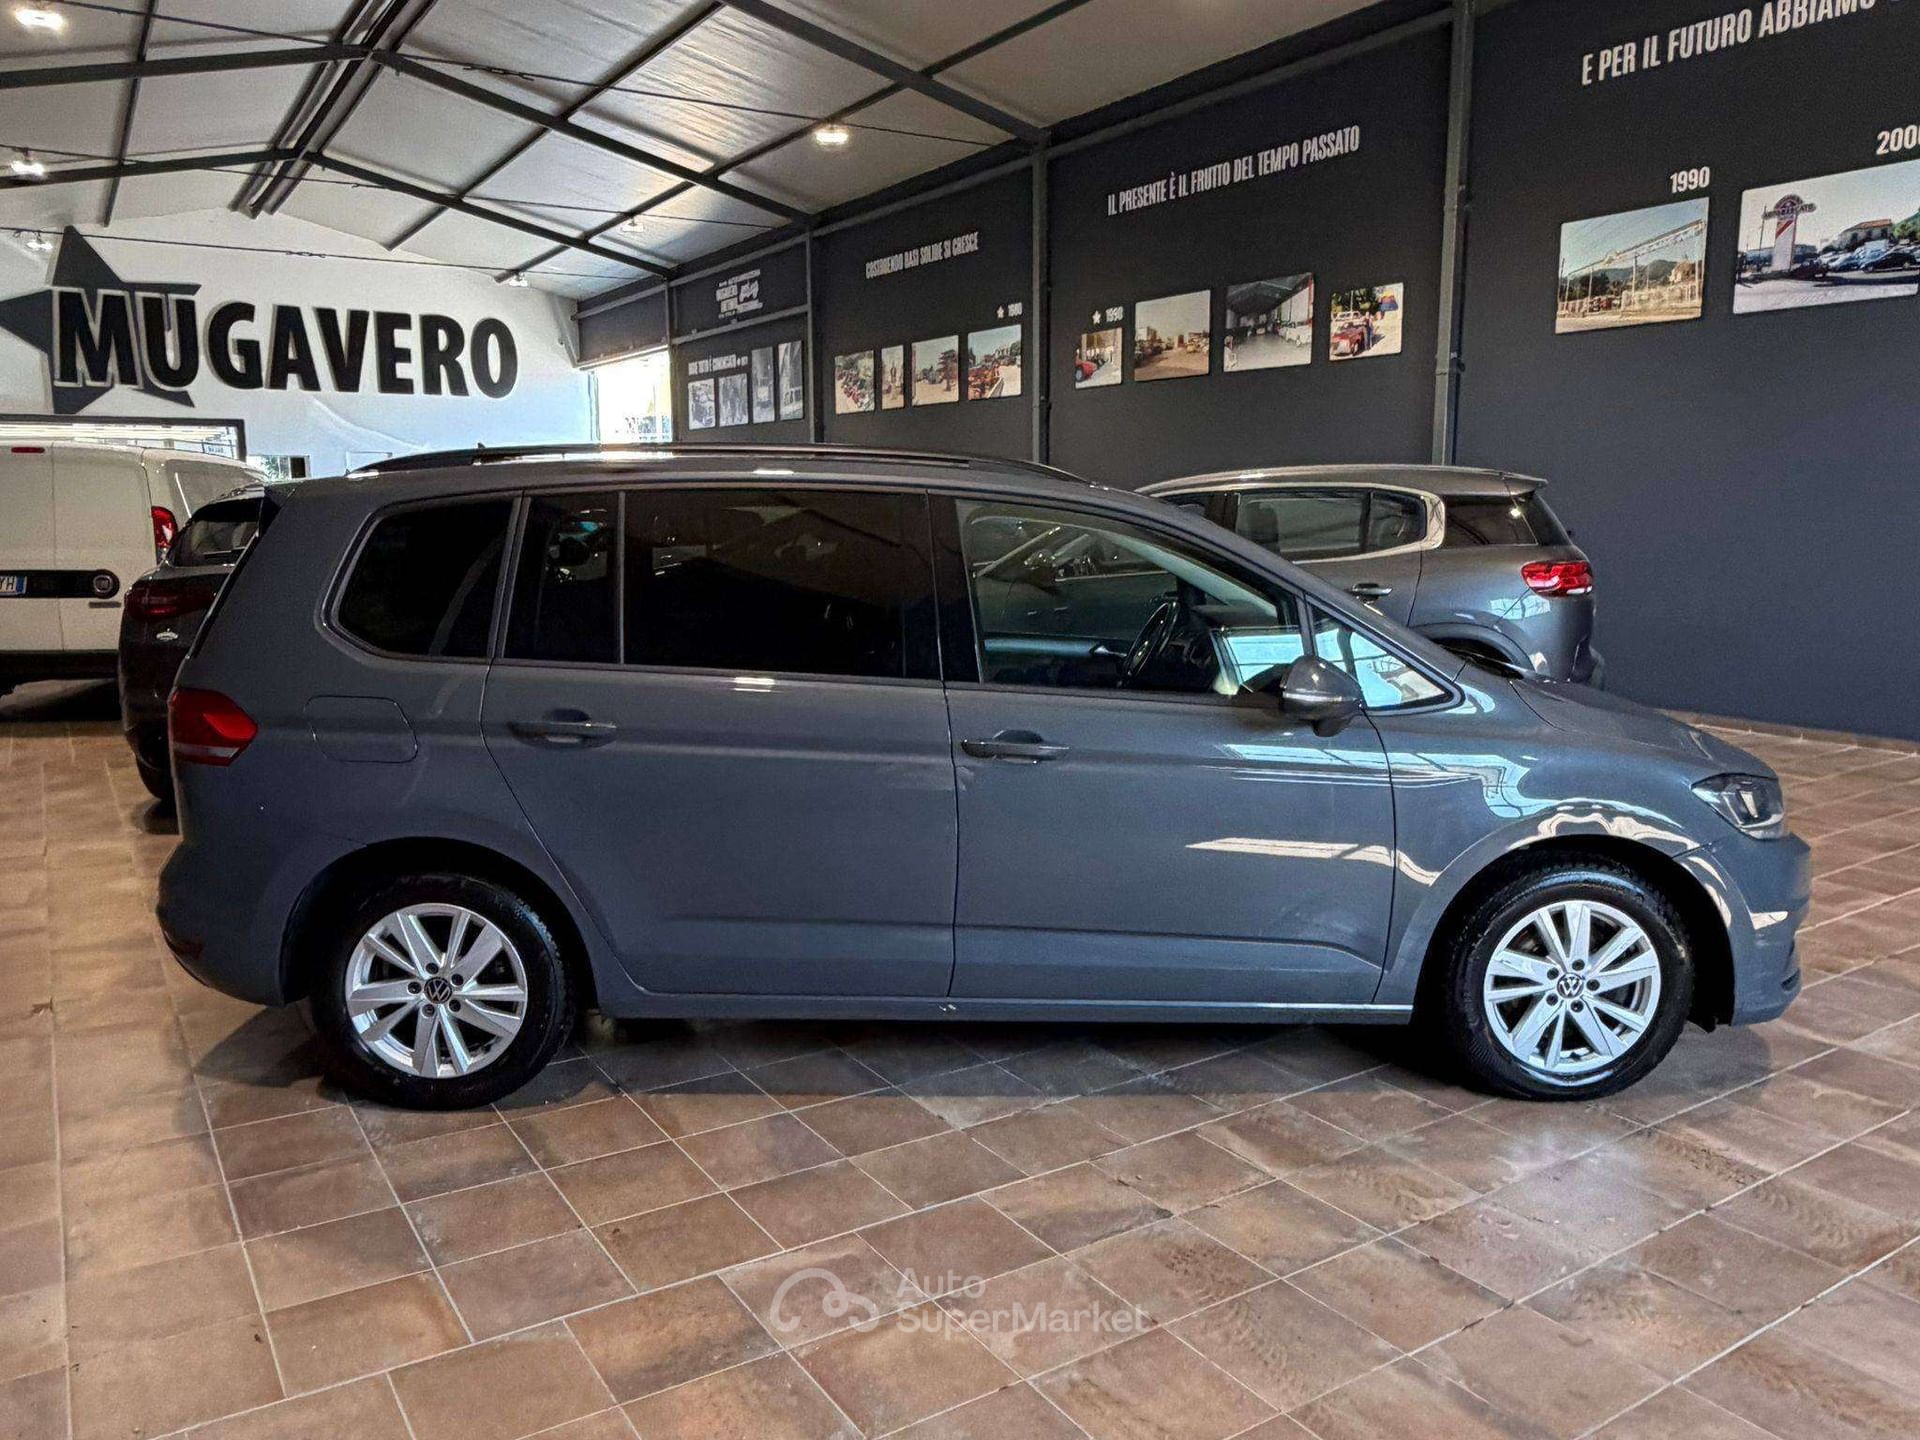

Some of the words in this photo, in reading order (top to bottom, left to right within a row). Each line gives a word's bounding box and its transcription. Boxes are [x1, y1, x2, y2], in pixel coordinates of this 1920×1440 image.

[1581, 54, 1593, 86] E
[1599, 42, 1636, 81] PER
[1642, 35, 1661, 69] IL
[1667, 9, 1752, 63] FUTURO
[1876, 124, 1920, 156] 200
[1107, 195, 1117, 216] IL
[1119, 178, 1167, 213] PRESENTE
[1169, 172, 1176, 199] È
[1178, 175, 1189, 197] IL
[1191, 162, 1230, 194] FRUTTO
[1233, 155, 1255, 183] DEL
[1257, 142, 1299, 176] TEMPO
[1302, 125, 1360, 165] PASSATO
[1670, 166, 1711, 194] 1990
[952, 231, 978, 256] CRESCE
[55, 290, 520, 399] MUGAVERO
